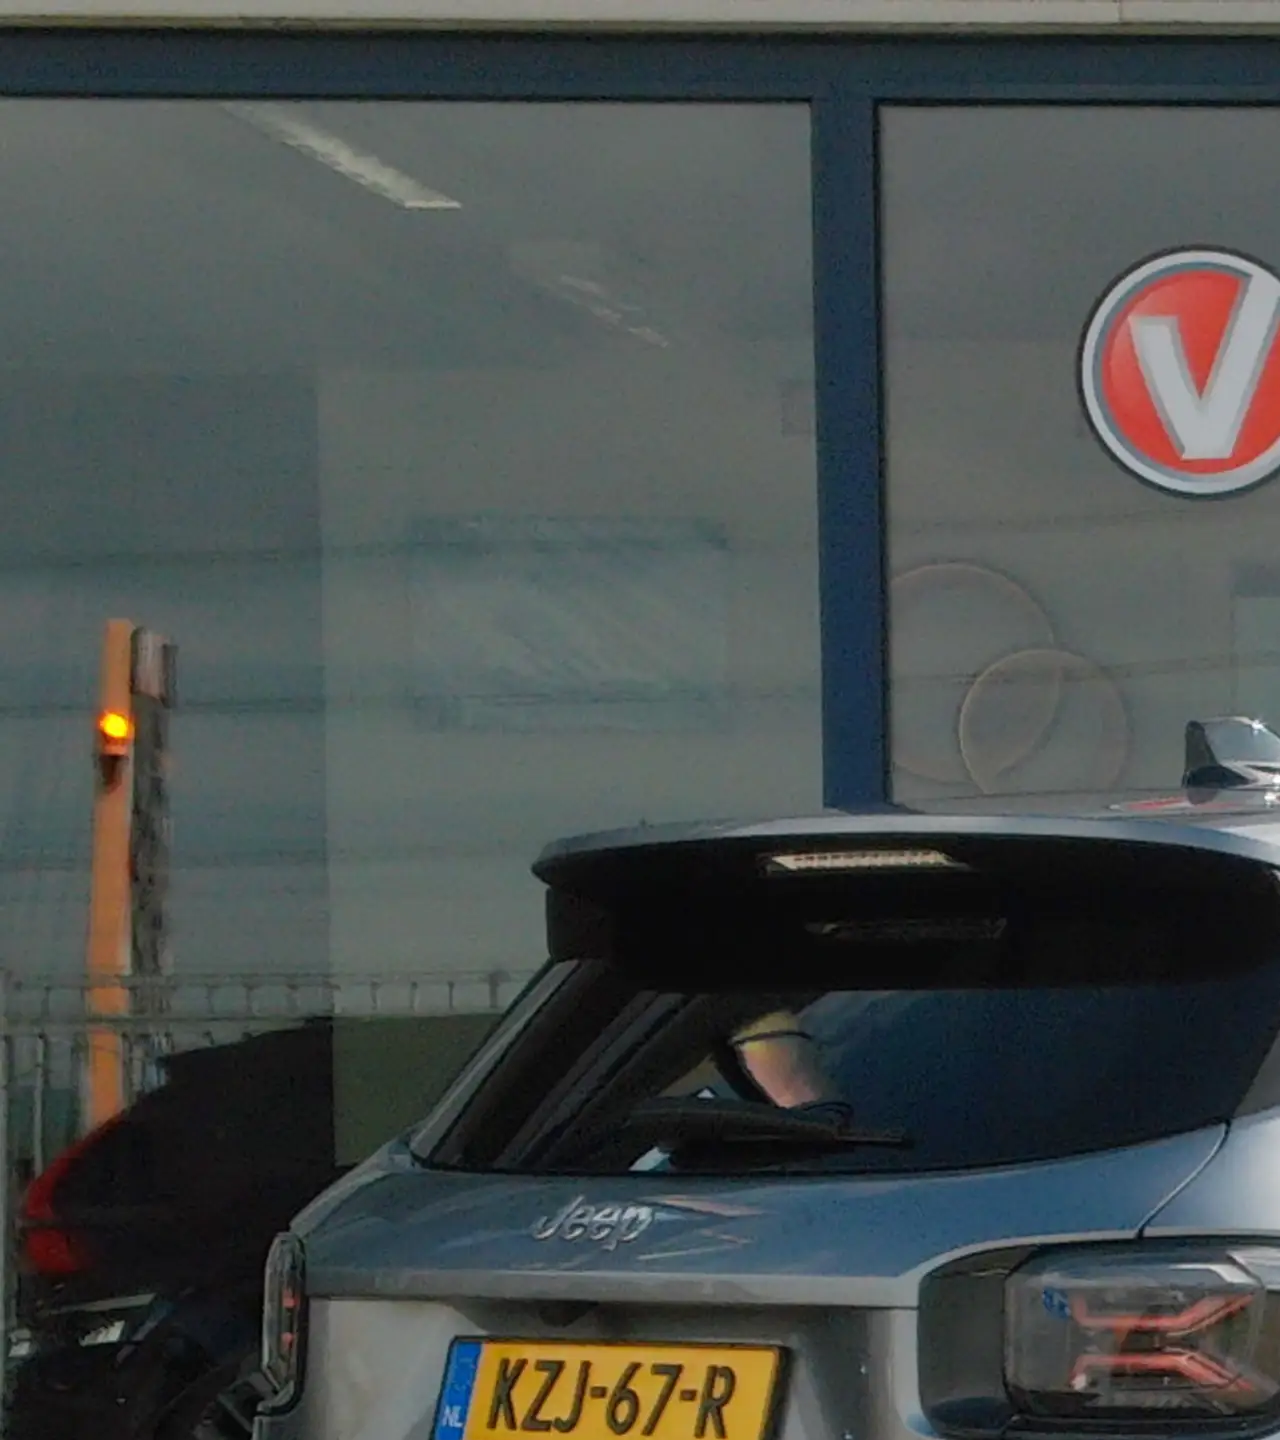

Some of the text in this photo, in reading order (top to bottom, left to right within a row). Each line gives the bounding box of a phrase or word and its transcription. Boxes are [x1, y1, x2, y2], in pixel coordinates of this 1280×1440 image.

[532, 1196, 656, 1251] Jeep
[441, 1404, 464, 1428] NL
[487, 1357, 738, 1440] KZJ-67-R
